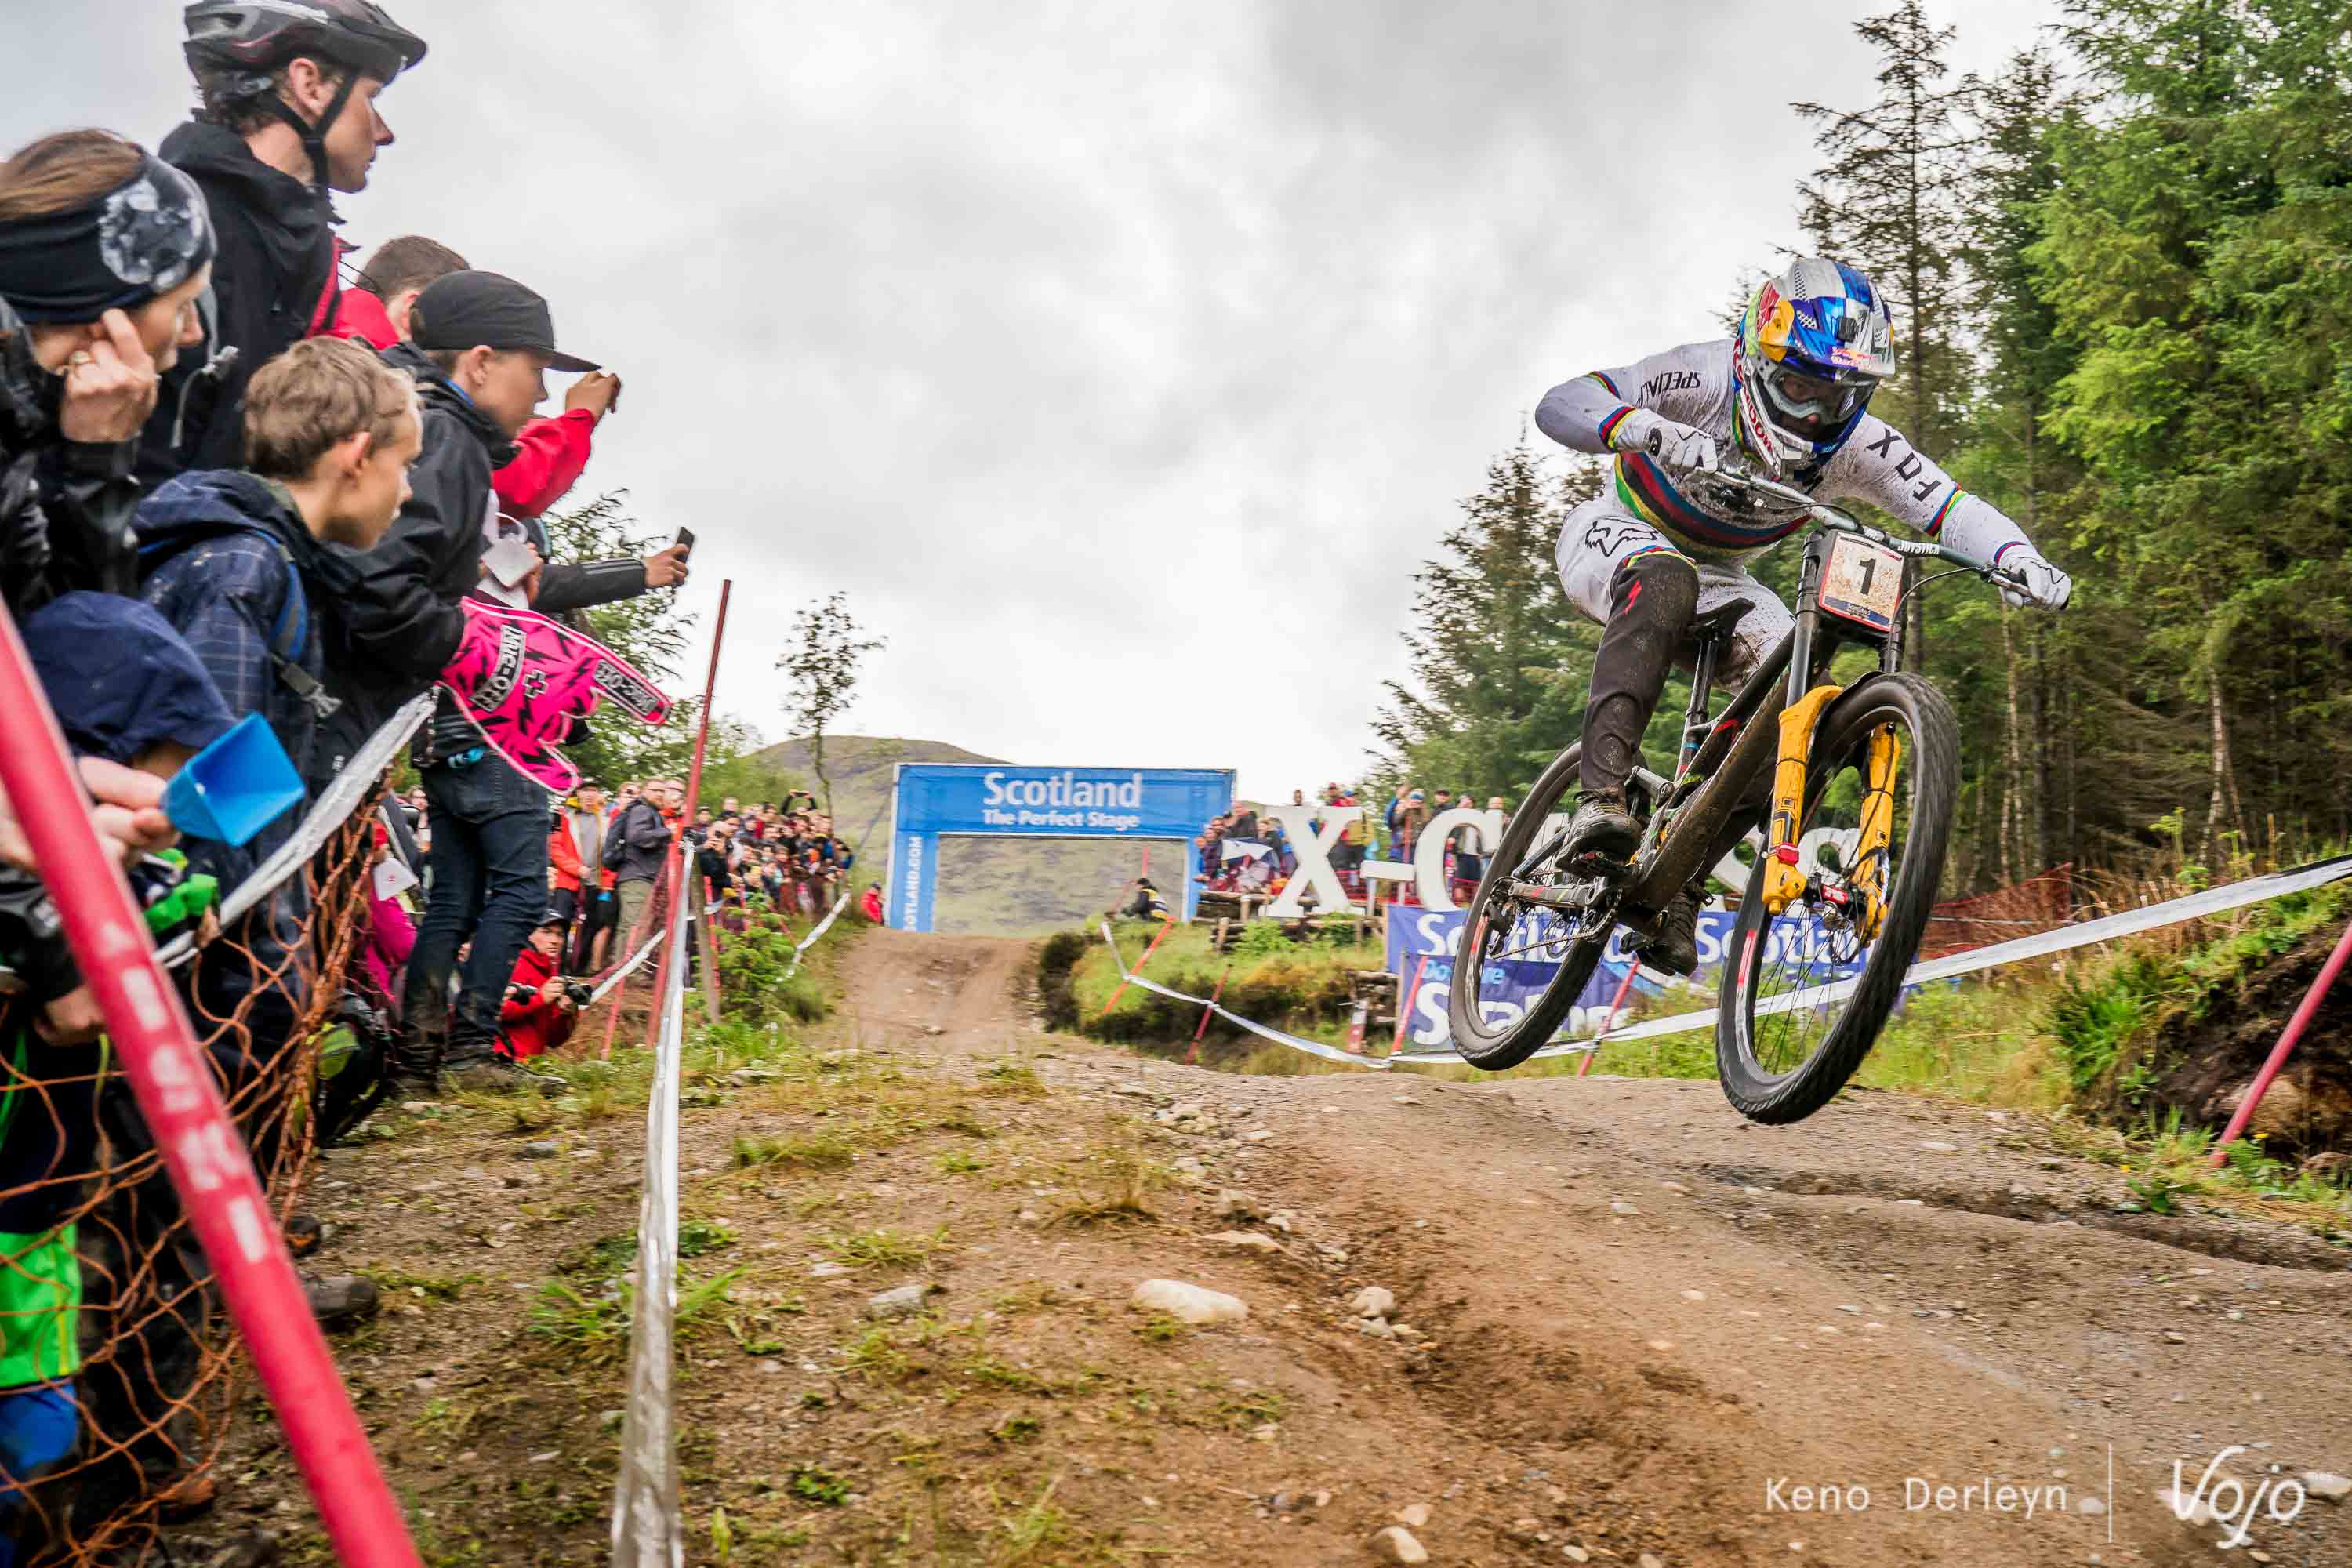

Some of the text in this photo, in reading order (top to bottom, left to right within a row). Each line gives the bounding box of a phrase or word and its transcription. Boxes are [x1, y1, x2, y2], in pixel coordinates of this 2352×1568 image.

[1865, 427, 1942, 502] FOX
[1859, 558, 1876, 596] 1
[982, 771, 1142, 808] Scotland
[982, 808, 1141, 831] The Perfect Stage
